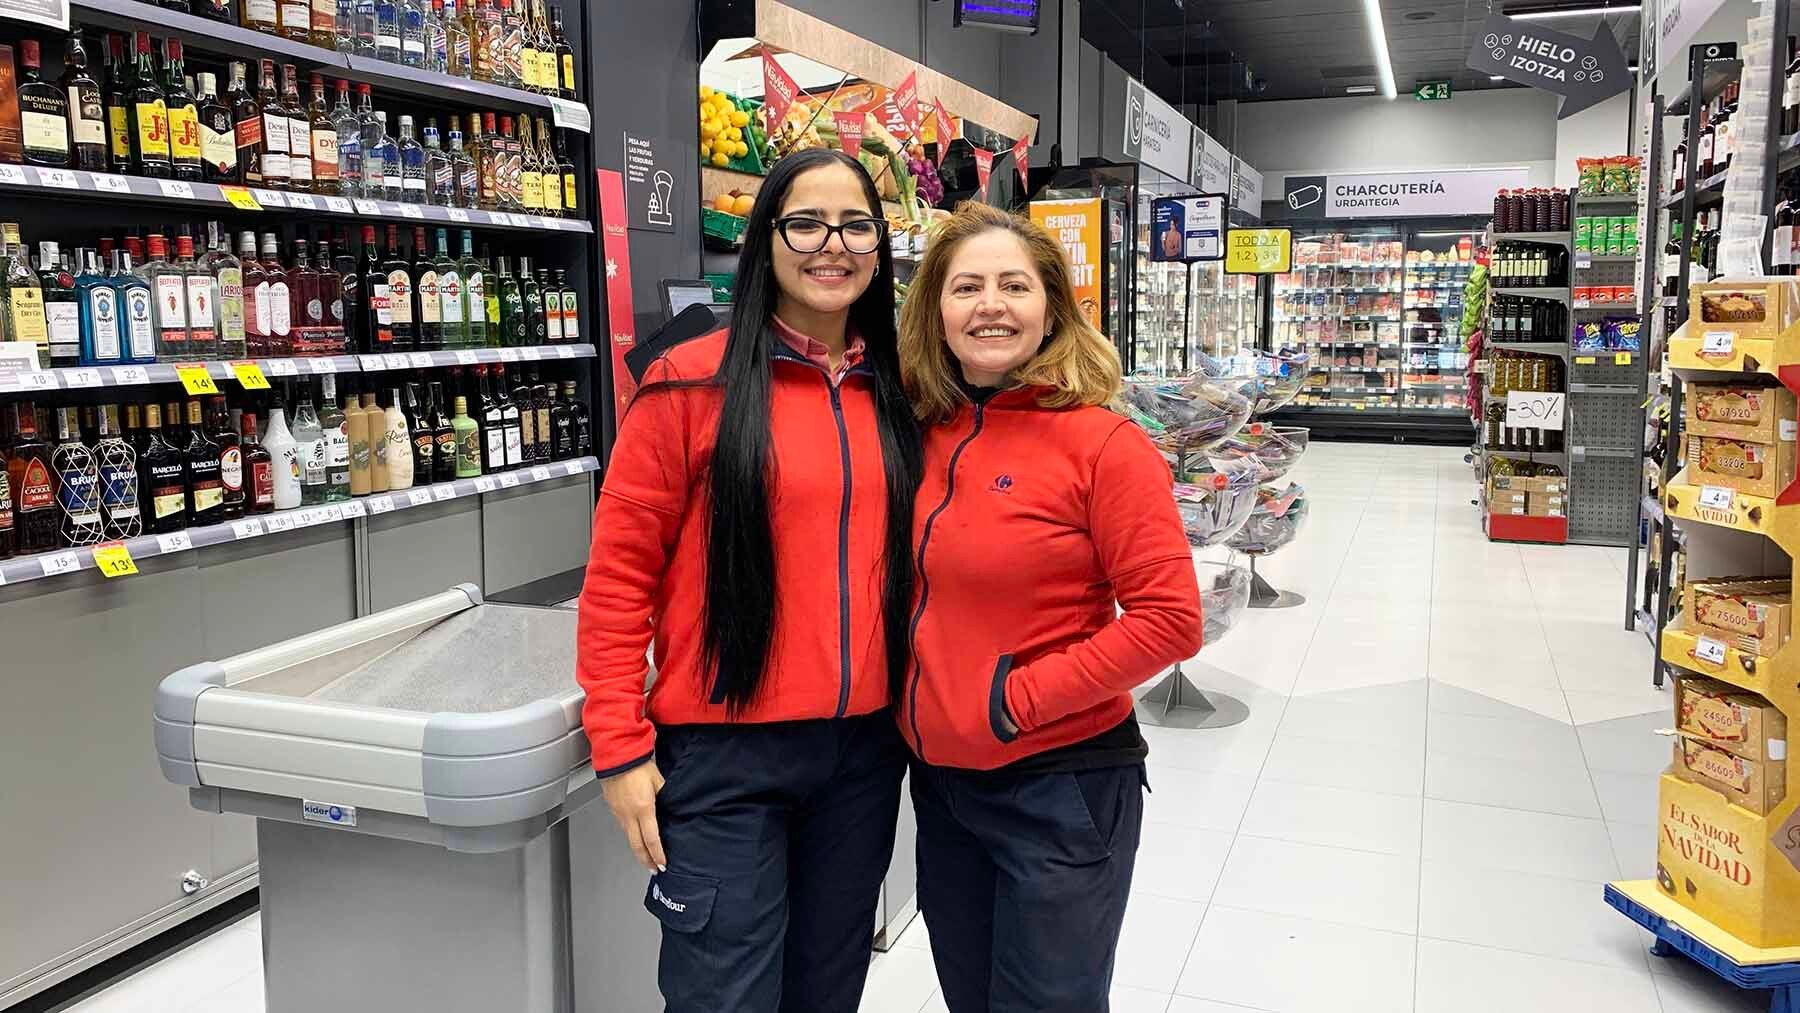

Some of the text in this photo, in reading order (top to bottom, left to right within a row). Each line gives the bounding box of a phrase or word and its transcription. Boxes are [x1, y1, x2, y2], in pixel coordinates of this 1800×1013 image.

[1517, 36, 1575, 63] HIELO
[1510, 56, 1566, 82] IZOTZA
[764, 63, 792, 99] Navidad
[1336, 180, 1445, 197] CHARCUTERÍA
[1335, 198, 1400, 208] URDAITEGIA
[1046, 214, 1086, 229] CERVEZA
[1060, 229, 1080, 242] CON
[1235, 236, 1267, 246] TODO
[221, 285, 244, 297] LARIOS
[152, 464, 183, 474] BARCELÓ
[191, 460, 220, 469] BARCELÓ
[1694, 506, 1738, 524] NAVIDAD
[1717, 611, 1747, 626] 75600
[305, 805, 328, 815] kider
[1670, 803, 1743, 855] EL SABOR
[1664, 824, 1751, 887] NAVIDAD
